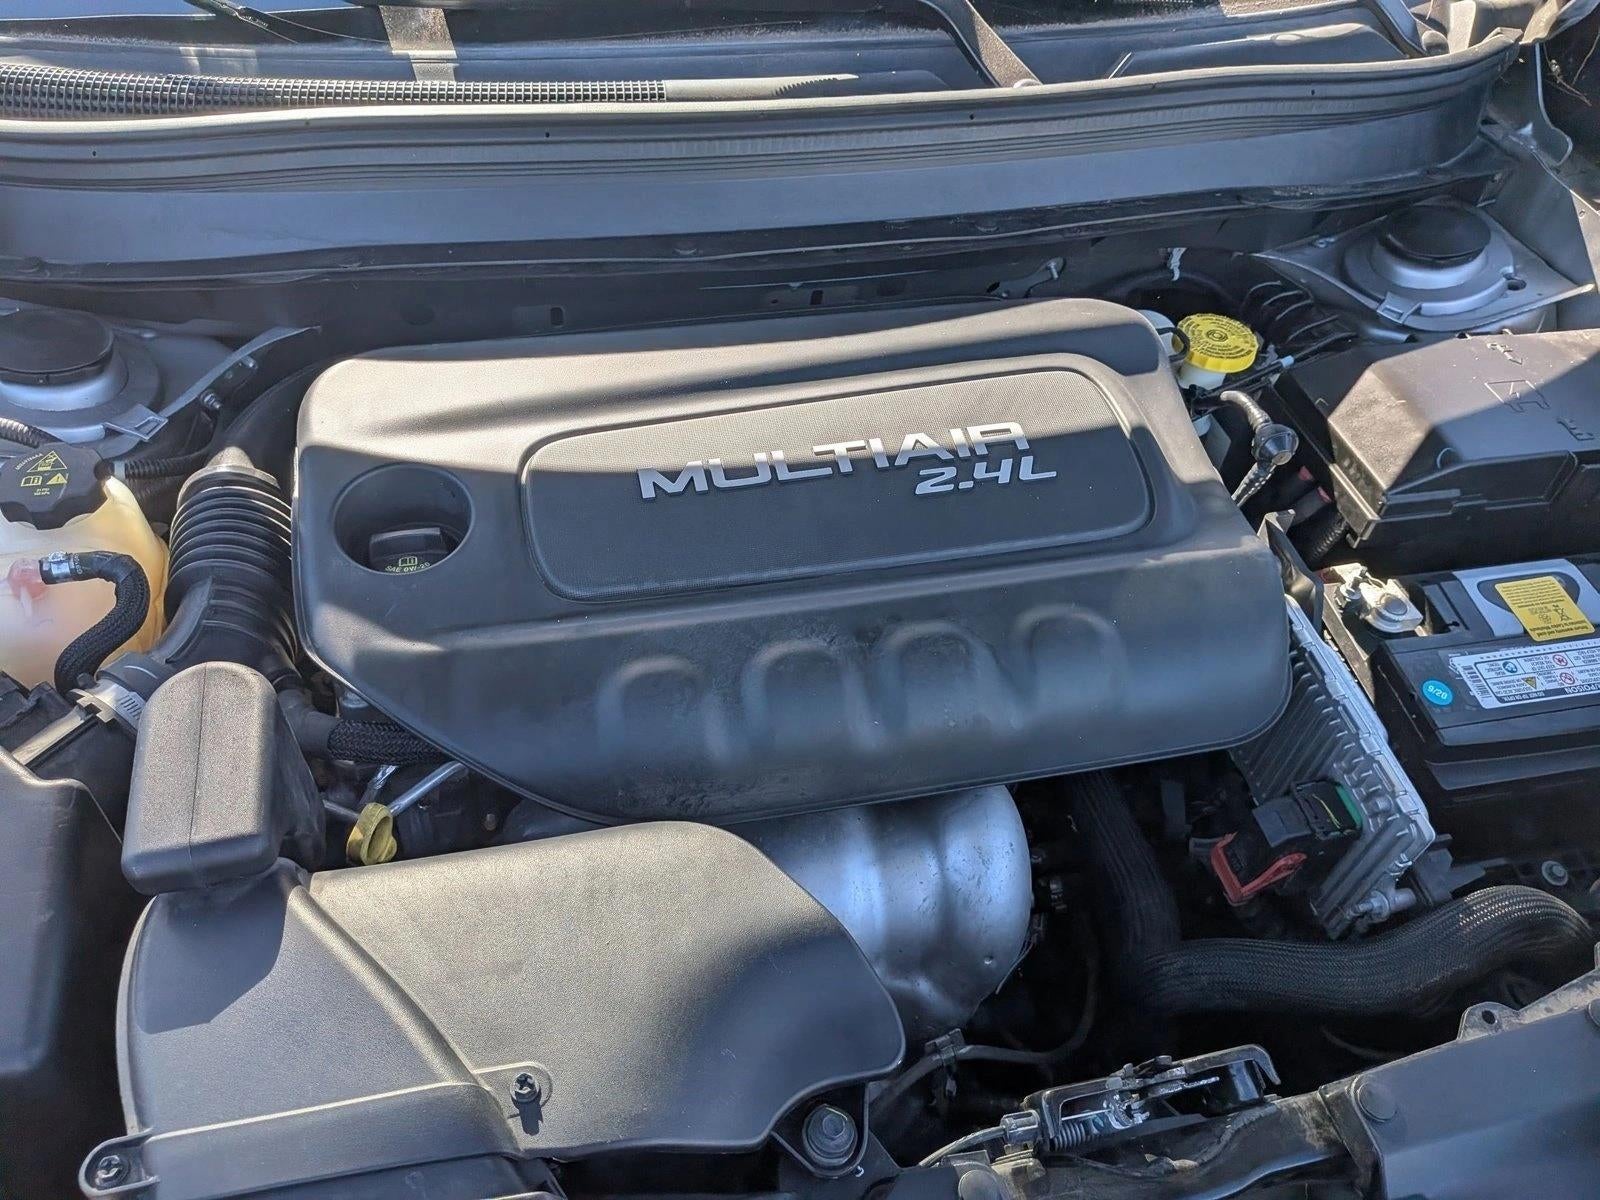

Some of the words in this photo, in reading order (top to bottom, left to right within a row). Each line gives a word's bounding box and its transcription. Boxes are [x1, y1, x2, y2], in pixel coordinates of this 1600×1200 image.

[637, 422, 1030, 499] MULTIAIR
[914, 455, 1057, 495] 2.4L
[385, 565, 402, 573] SAE
[403, 562, 431, 572] 0W-20
